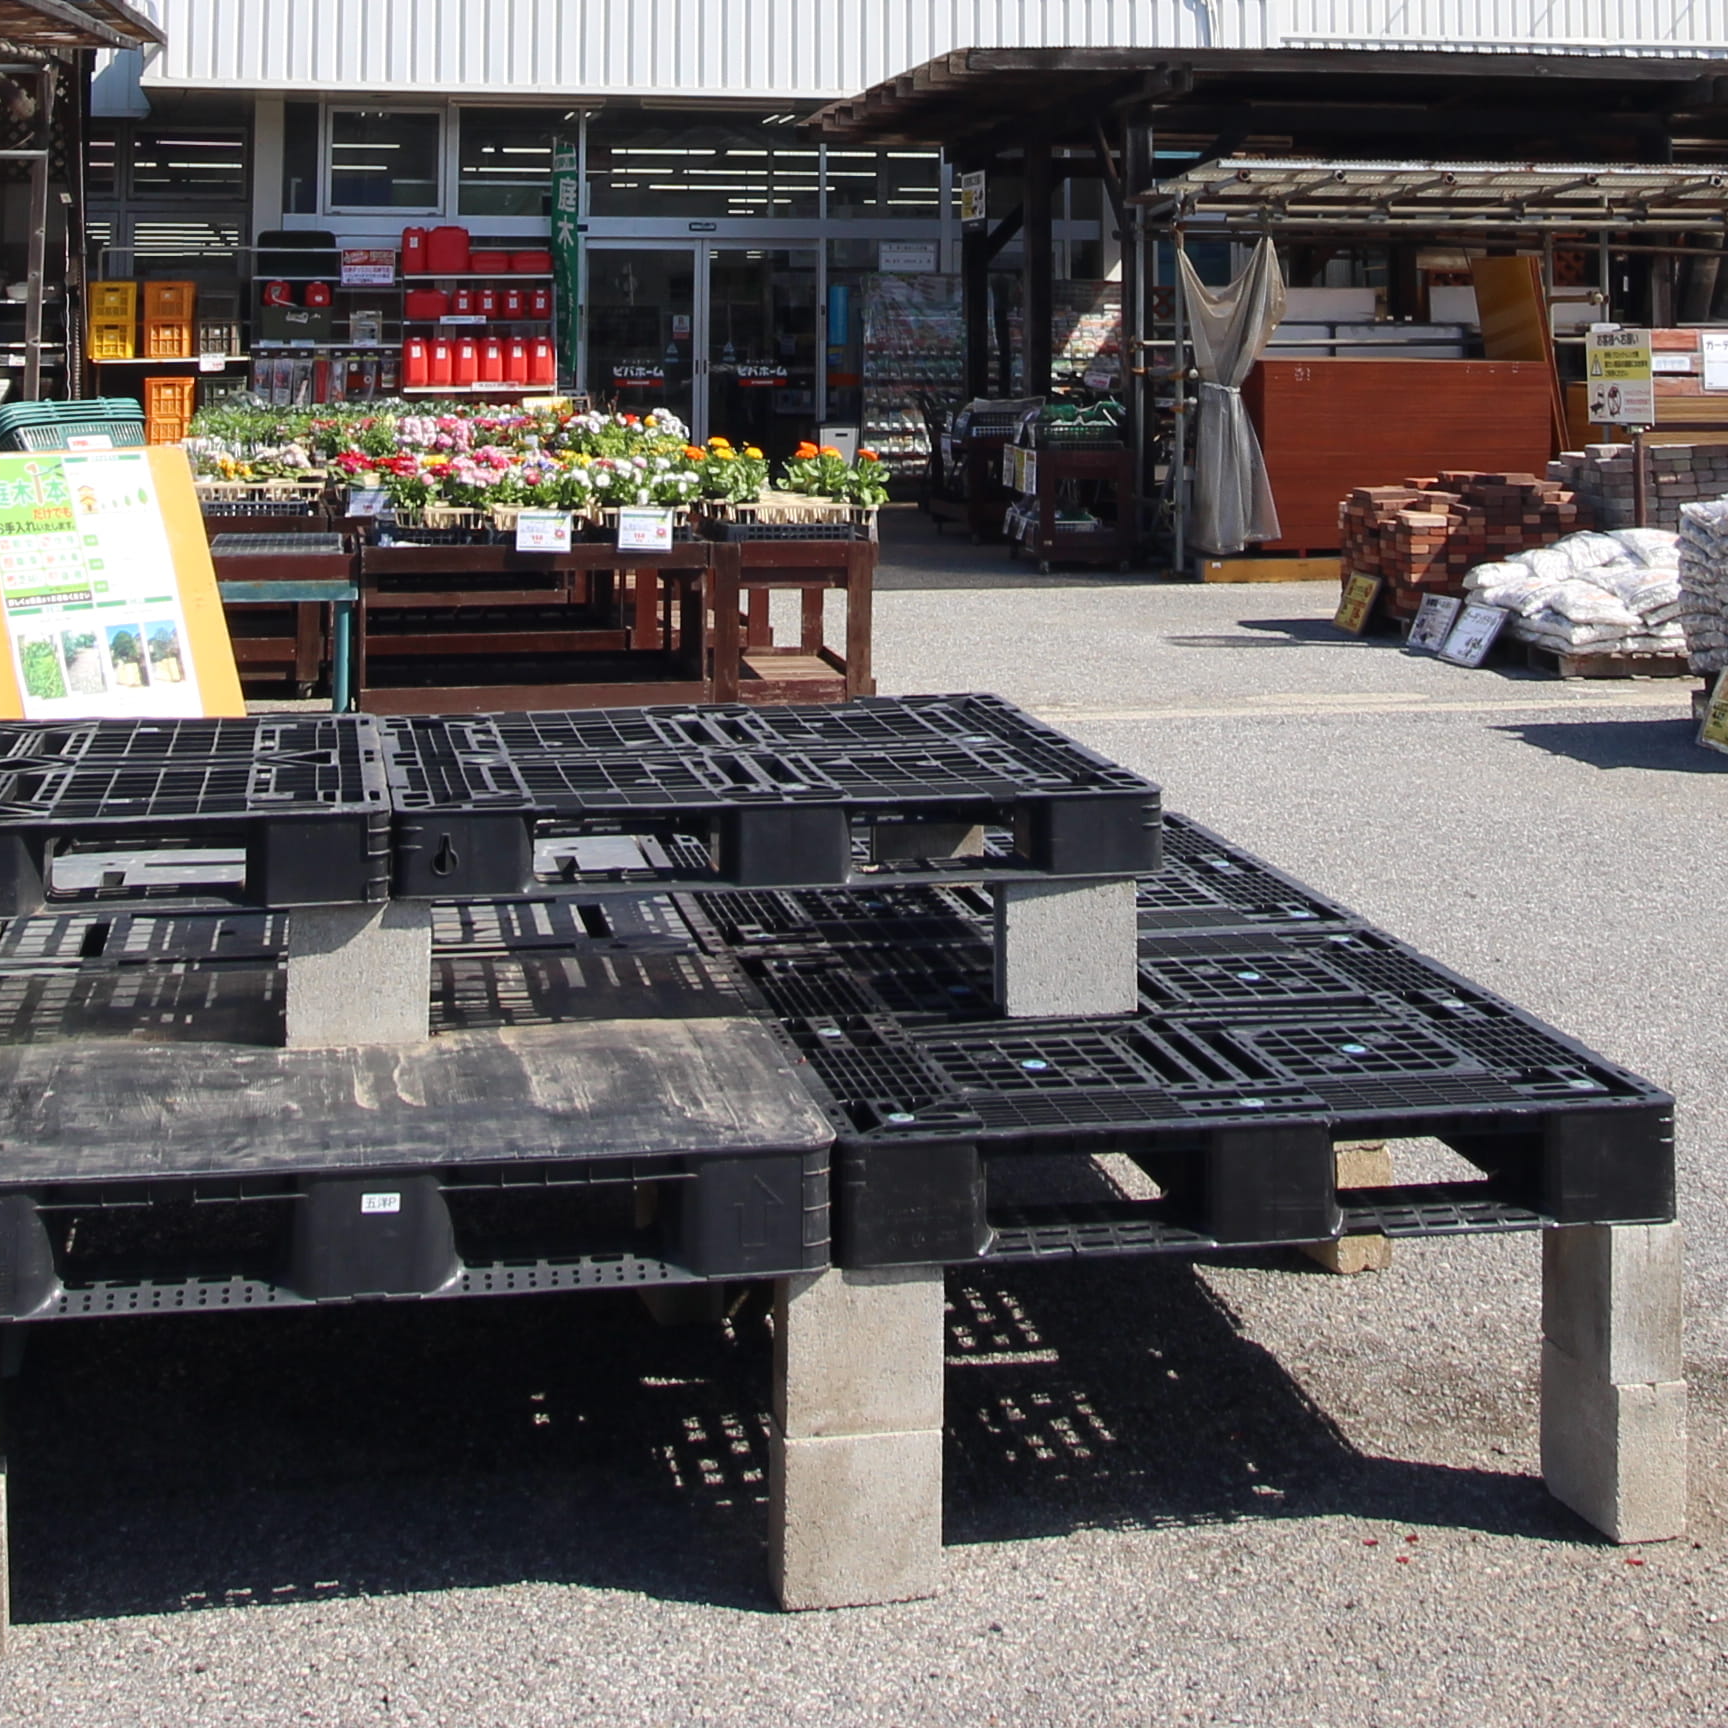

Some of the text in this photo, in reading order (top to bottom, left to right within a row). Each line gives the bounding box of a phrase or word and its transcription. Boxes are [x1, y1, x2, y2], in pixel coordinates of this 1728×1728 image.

[613, 365, 664, 377] ビバホーム
[33, 507, 73, 520] だけでも
